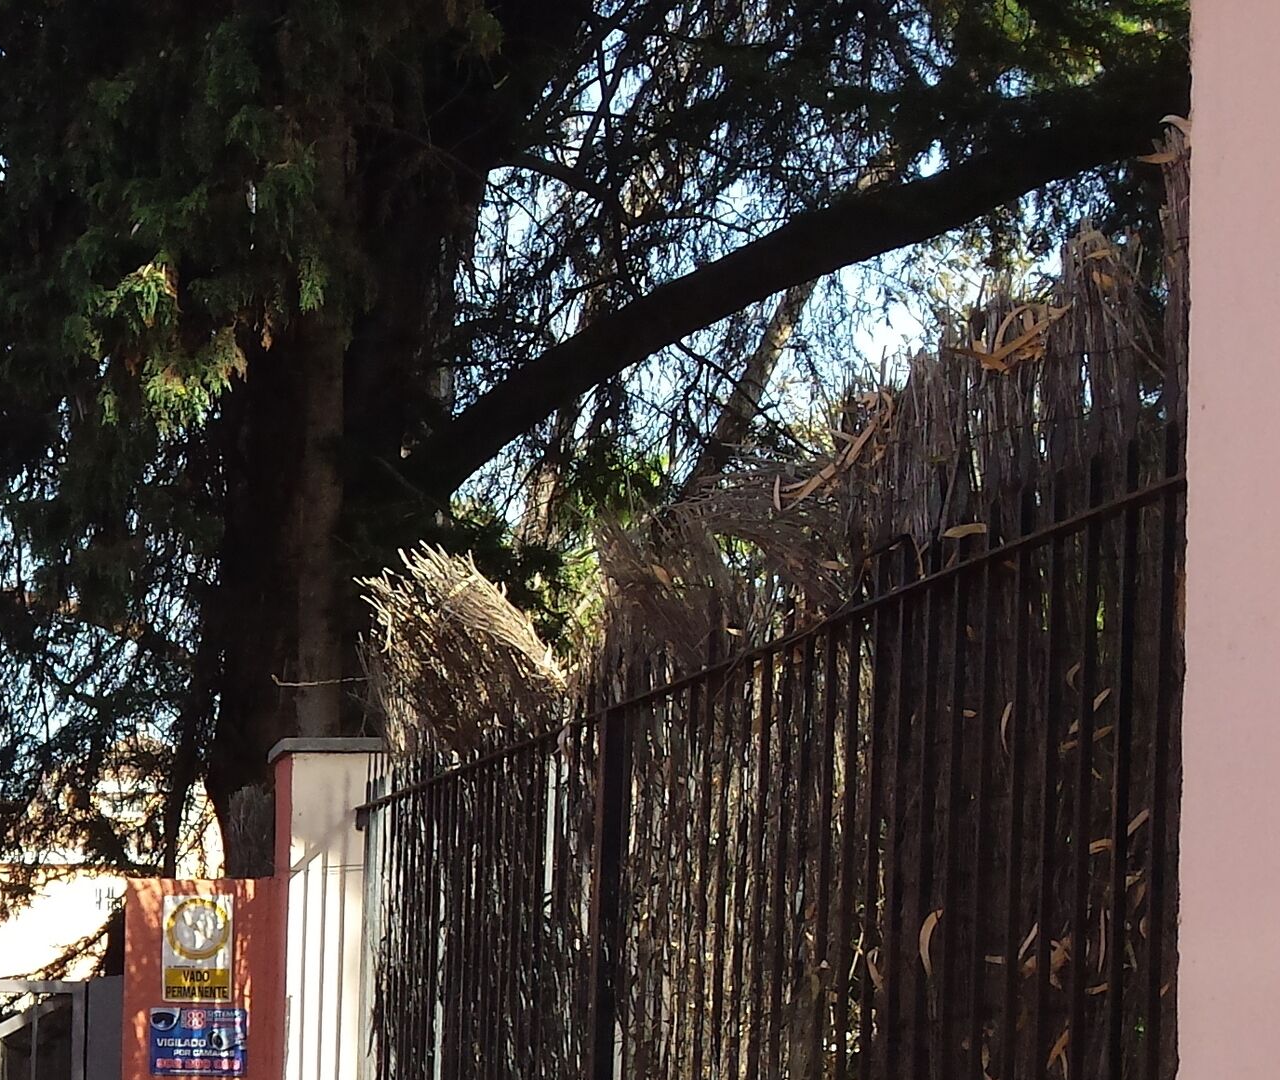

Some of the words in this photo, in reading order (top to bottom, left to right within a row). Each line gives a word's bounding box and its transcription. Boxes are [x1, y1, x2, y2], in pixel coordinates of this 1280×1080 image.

[183, 970, 210, 982] VADO
[165, 986, 228, 999] PERMANENTE
[156, 1038, 206, 1047] VIGILADO
